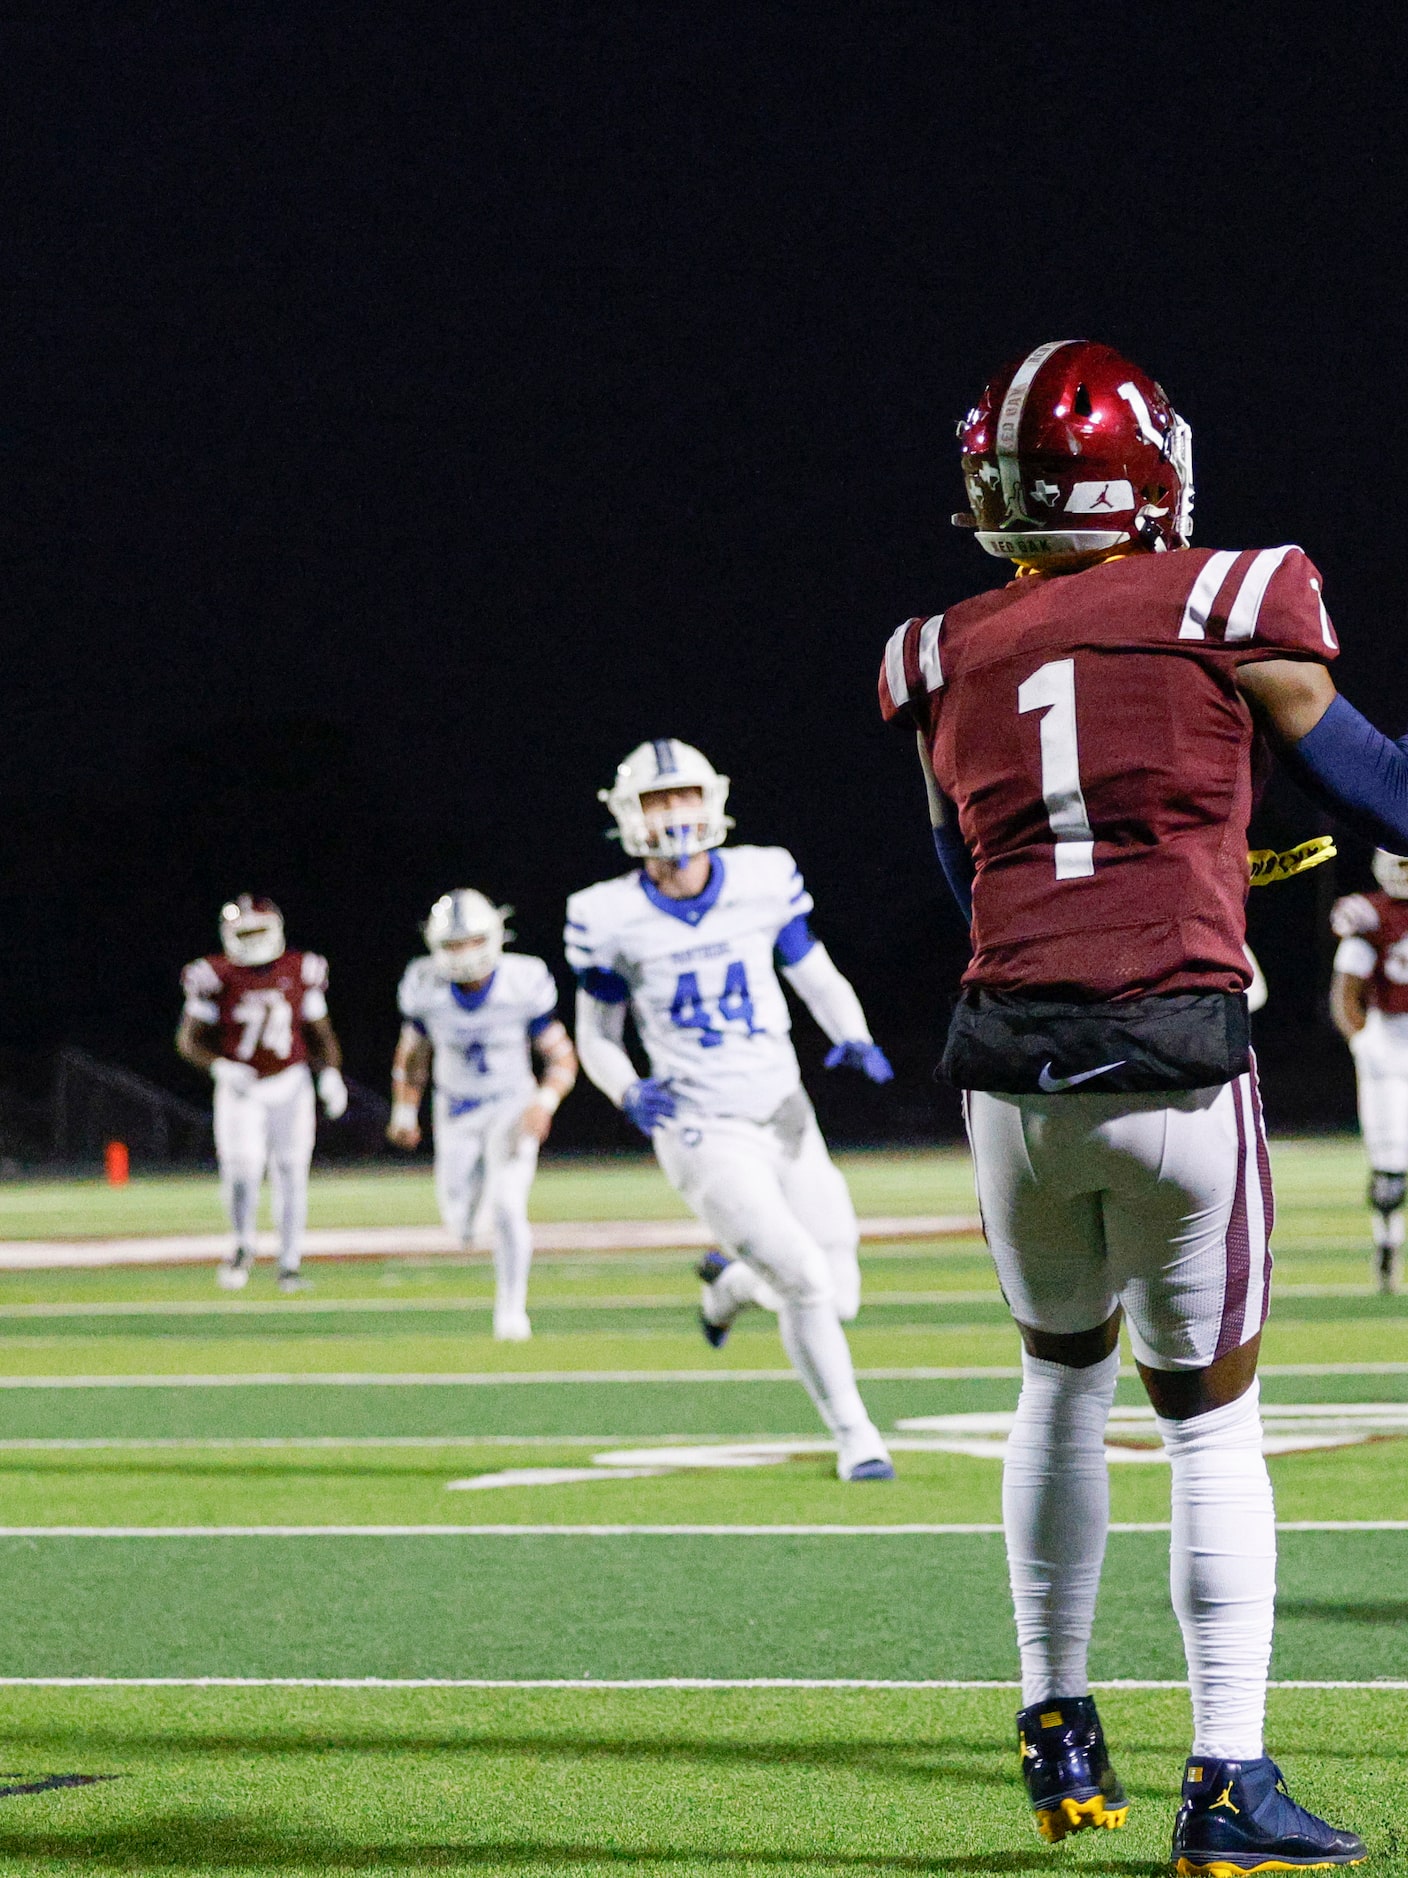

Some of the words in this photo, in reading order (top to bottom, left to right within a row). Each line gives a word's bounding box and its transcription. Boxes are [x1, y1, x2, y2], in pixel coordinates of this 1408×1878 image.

[1117, 381, 1165, 451] 1
[1018, 658, 1095, 881] 1
[231, 989, 294, 1060] 74
[669, 960, 766, 1049] 44
